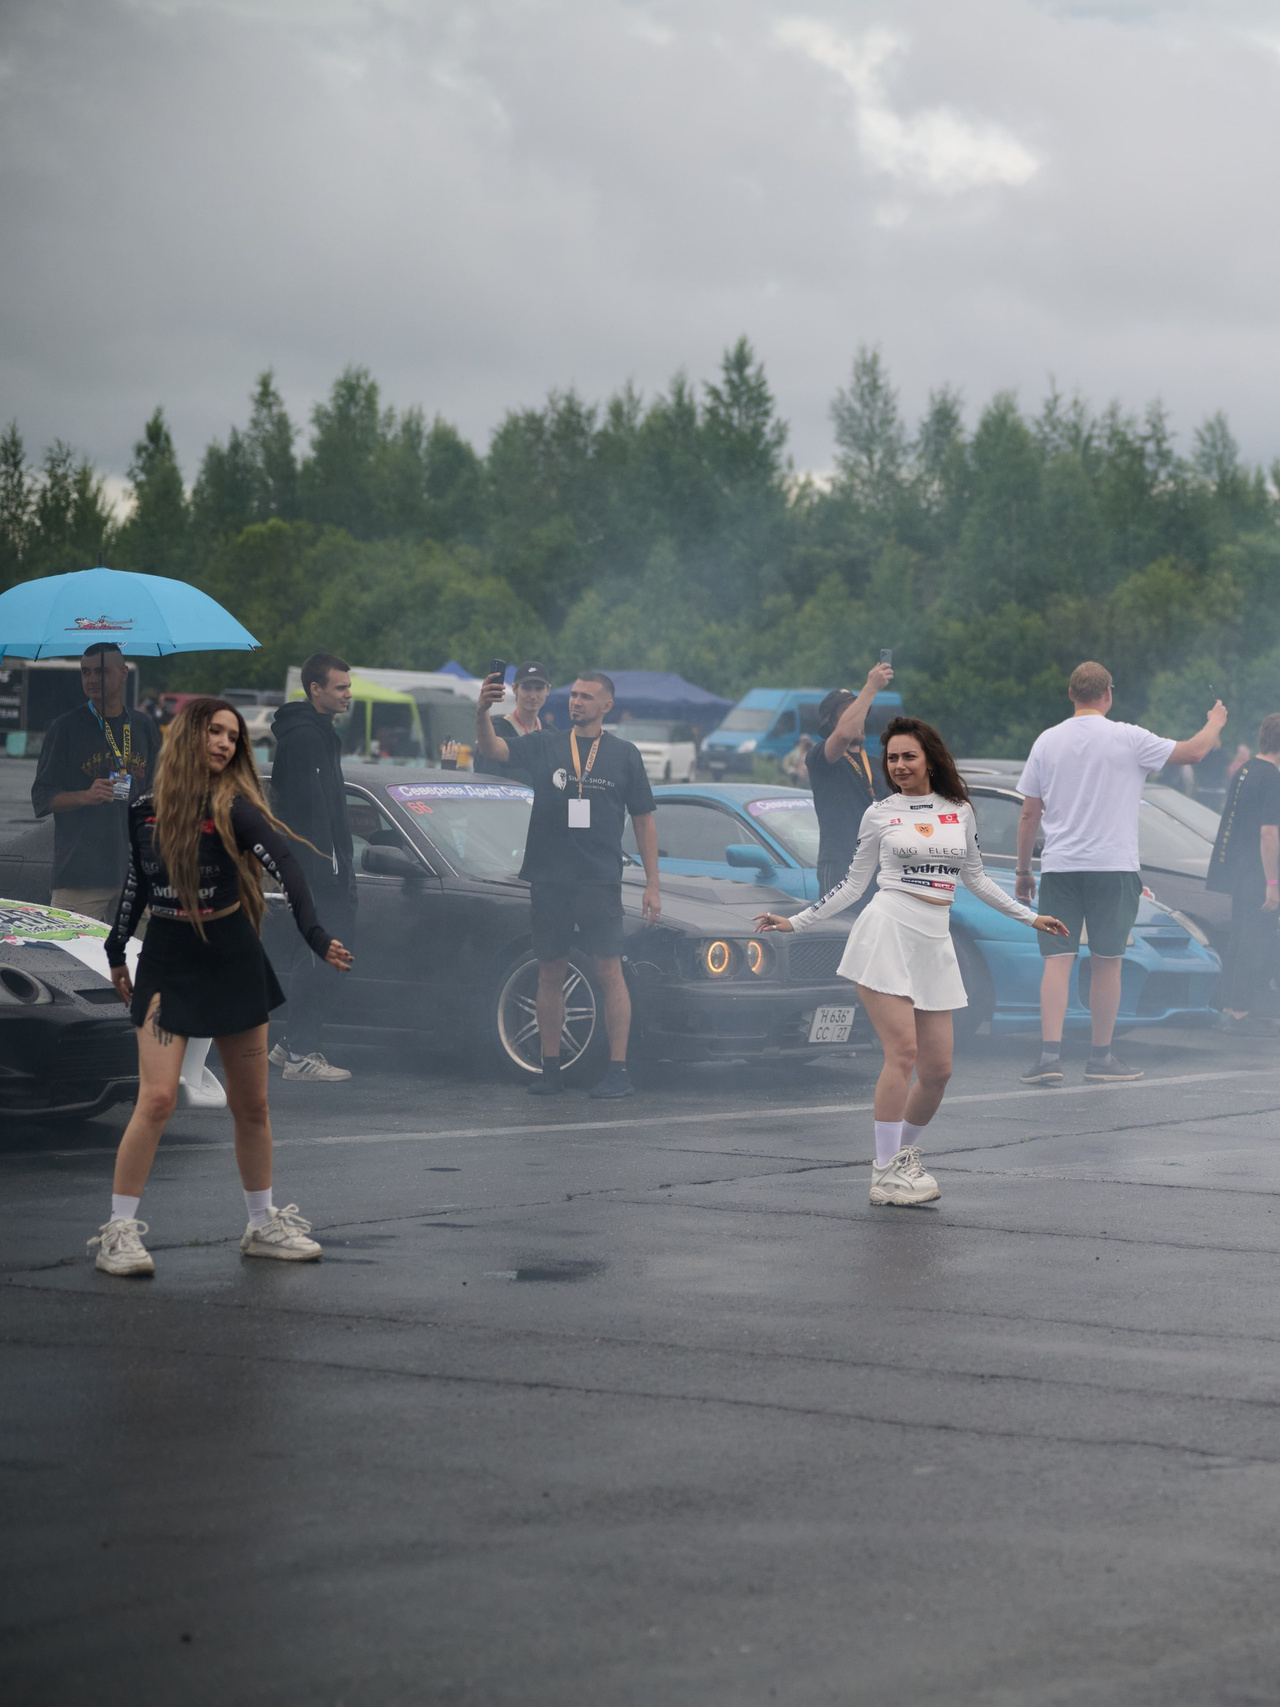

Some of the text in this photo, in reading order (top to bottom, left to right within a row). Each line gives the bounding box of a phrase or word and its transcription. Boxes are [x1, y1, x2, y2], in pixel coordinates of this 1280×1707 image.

[587, 743, 598, 770] CARFEST
[399, 785, 465, 797] Северная
[407, 801, 434, 815] 66
[902, 863, 961, 876] Evdriver
